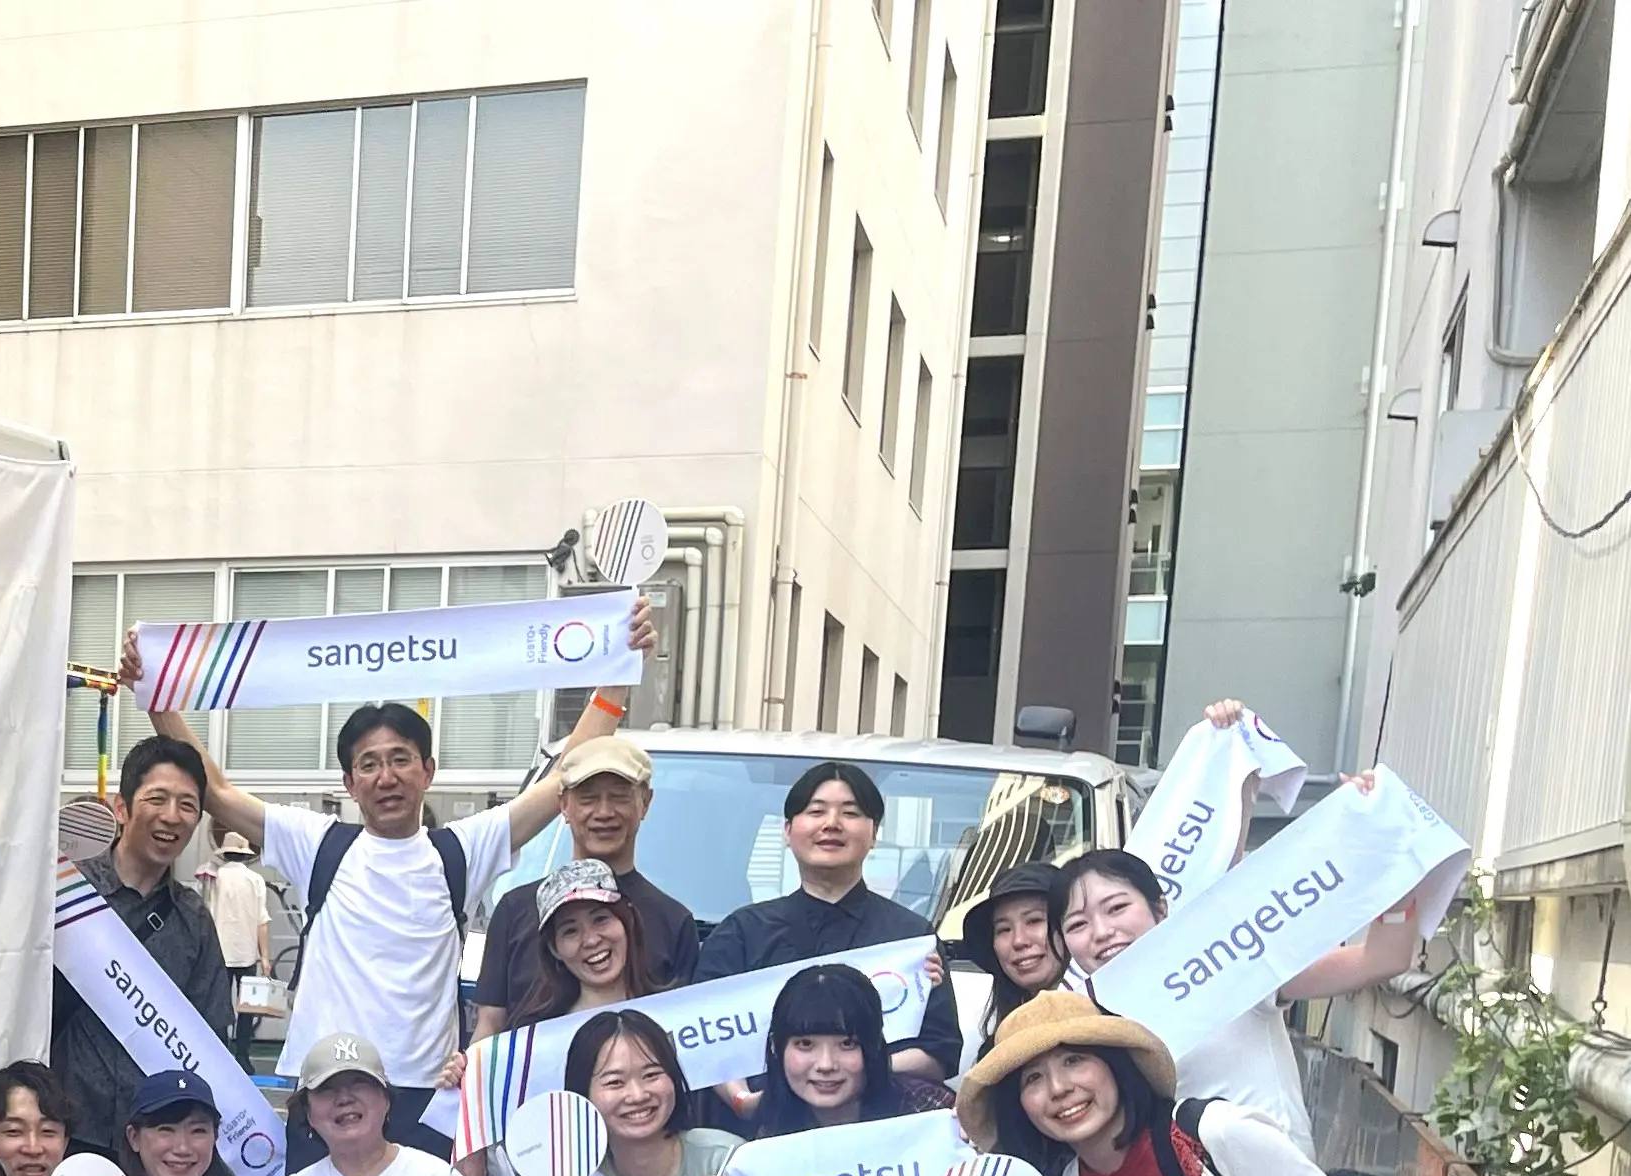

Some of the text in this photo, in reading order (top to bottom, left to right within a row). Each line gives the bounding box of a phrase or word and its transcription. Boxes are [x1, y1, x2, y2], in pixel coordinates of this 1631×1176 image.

[306, 634, 459, 672] sangetsu
[1163, 859, 1344, 1001] sangetsu
[104, 959, 200, 1073] sangetsu
[667, 1012, 758, 1053] etsu
